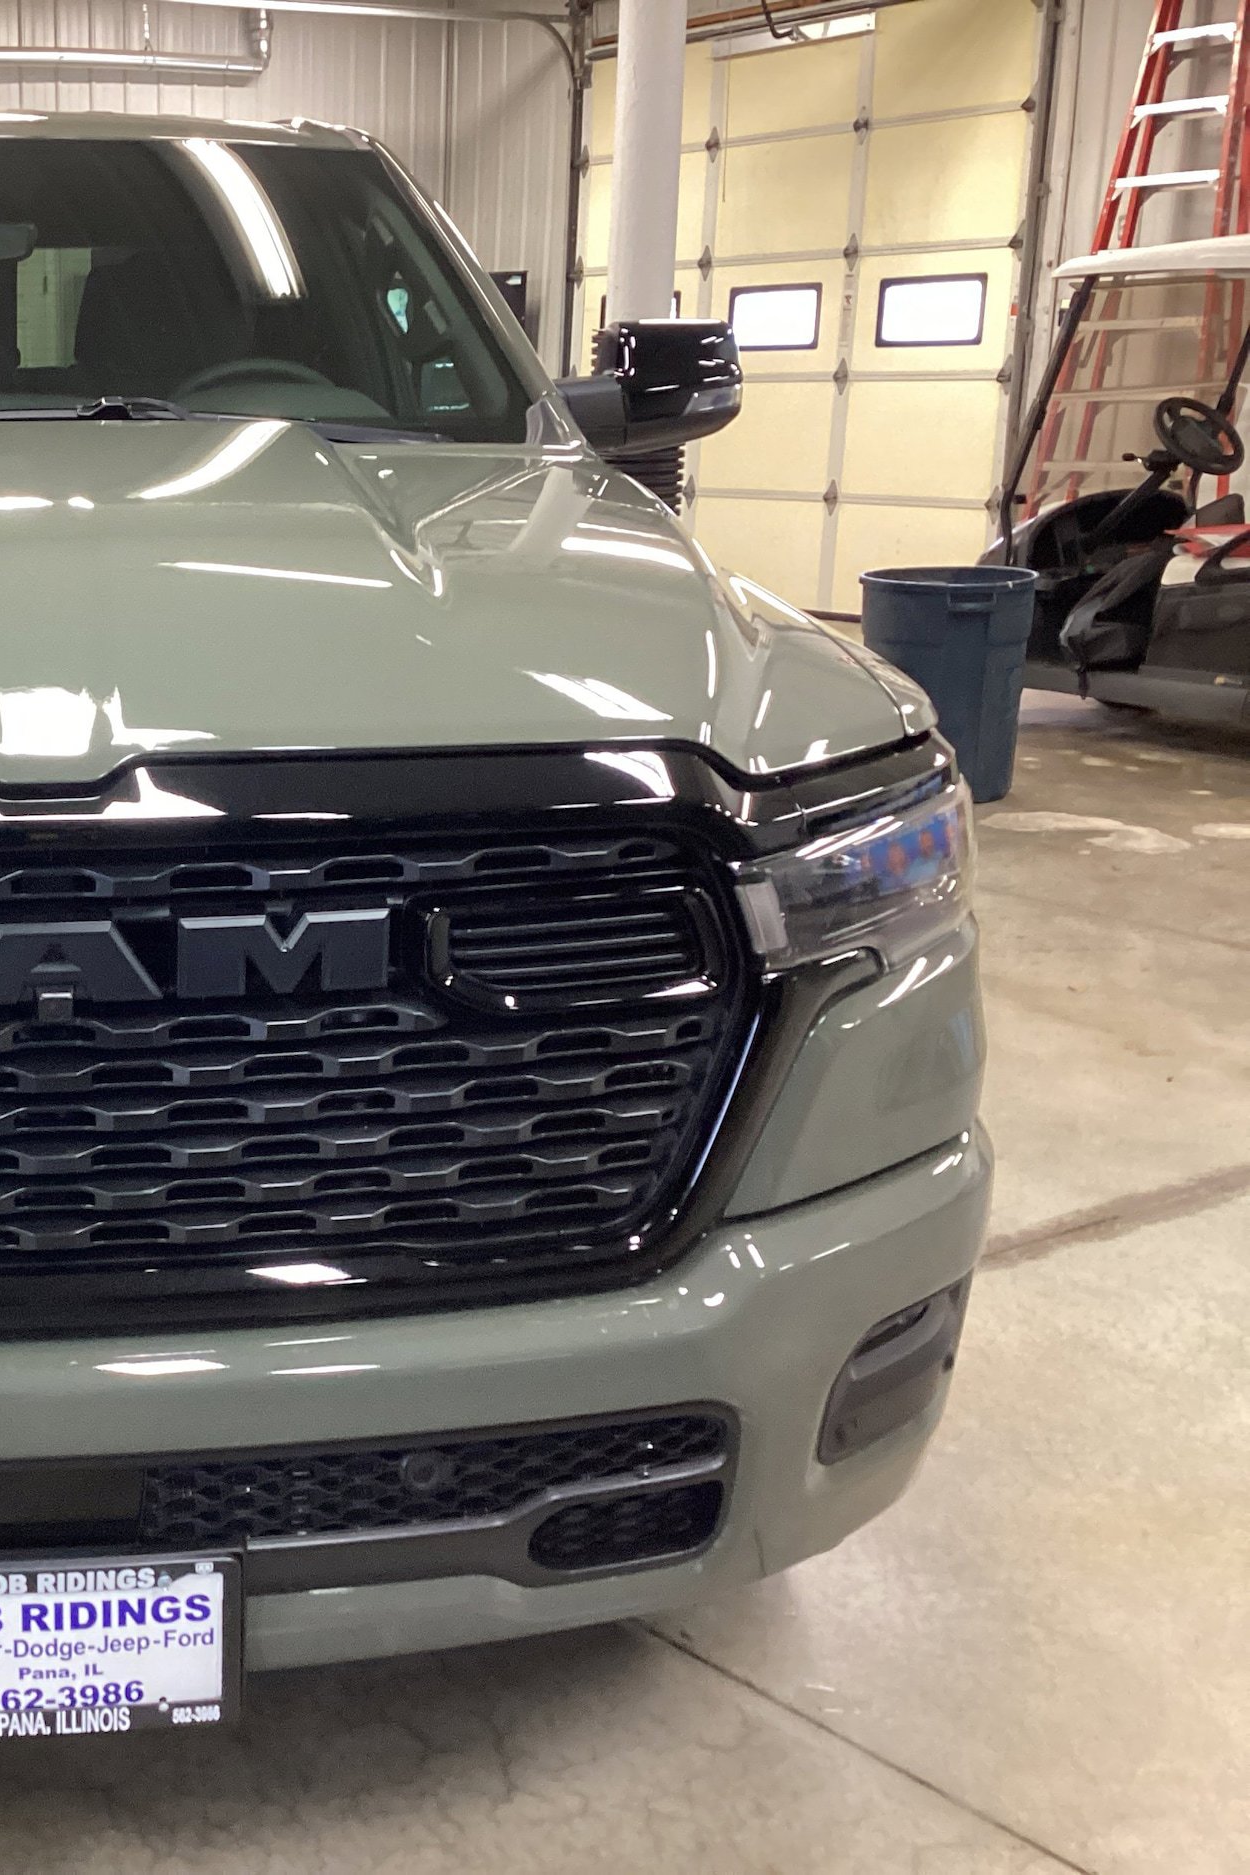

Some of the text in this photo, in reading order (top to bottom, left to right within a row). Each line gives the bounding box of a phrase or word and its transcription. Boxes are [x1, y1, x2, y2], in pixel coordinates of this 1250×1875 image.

[36, 1567, 156, 1594] RIDINGS
[21, 1594, 212, 1632] RIDINGS
[18, 1663, 104, 1680] Pana, IL
[56, 1706, 131, 1735] ILLINOIS
